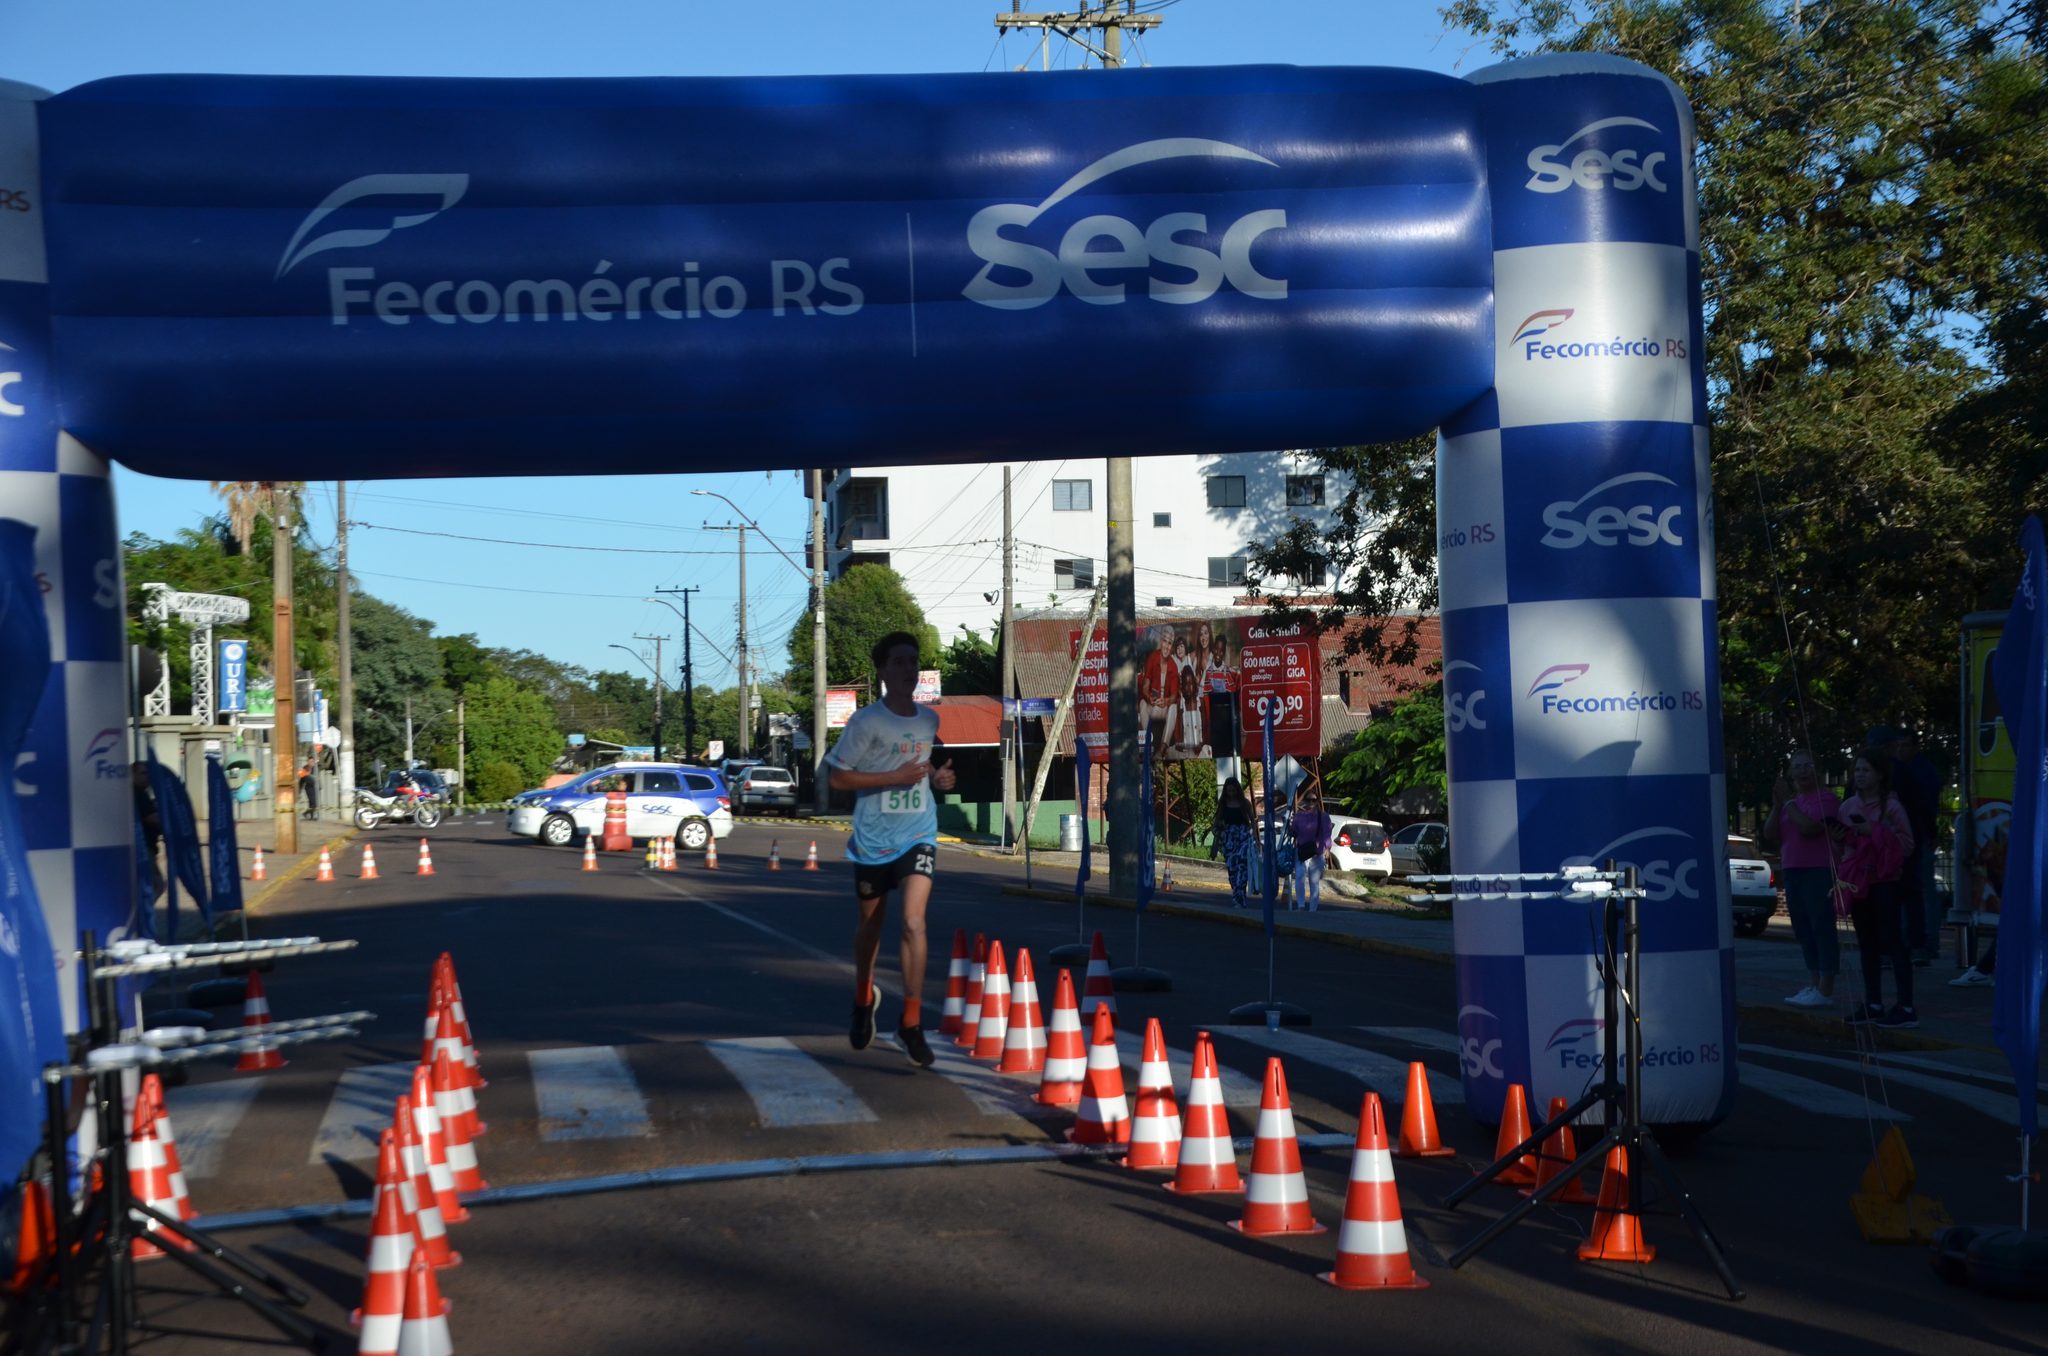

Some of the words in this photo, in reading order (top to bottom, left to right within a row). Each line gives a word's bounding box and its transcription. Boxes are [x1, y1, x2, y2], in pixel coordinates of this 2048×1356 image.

[1525, 116, 1667, 193] Sesc
[962, 137, 1288, 310] Sesc
[328, 259, 748, 325] Fecomércio
[771, 257, 865, 318] RS
[1526, 337, 1661, 361] Fecomércio
[1666, 338, 1686, 359] RS
[1540, 472, 1682, 549] Sesc
[1471, 523, 1495, 544] RS
[1243, 658, 1258, 668] 600
[1259, 656, 1280, 667] MEGA
[1287, 655, 1298, 666] 60
[1287, 667, 1305, 678] GIGA
[226, 663, 242, 709] URI
[1543, 691, 1677, 715] Fecomércio
[1682, 691, 1703, 711] RS
[889, 789, 921, 810] 516
[915, 853, 934, 874] 25
[1561, 1045, 1695, 1069] Fecércio
[1700, 1044, 1720, 1064] RS
